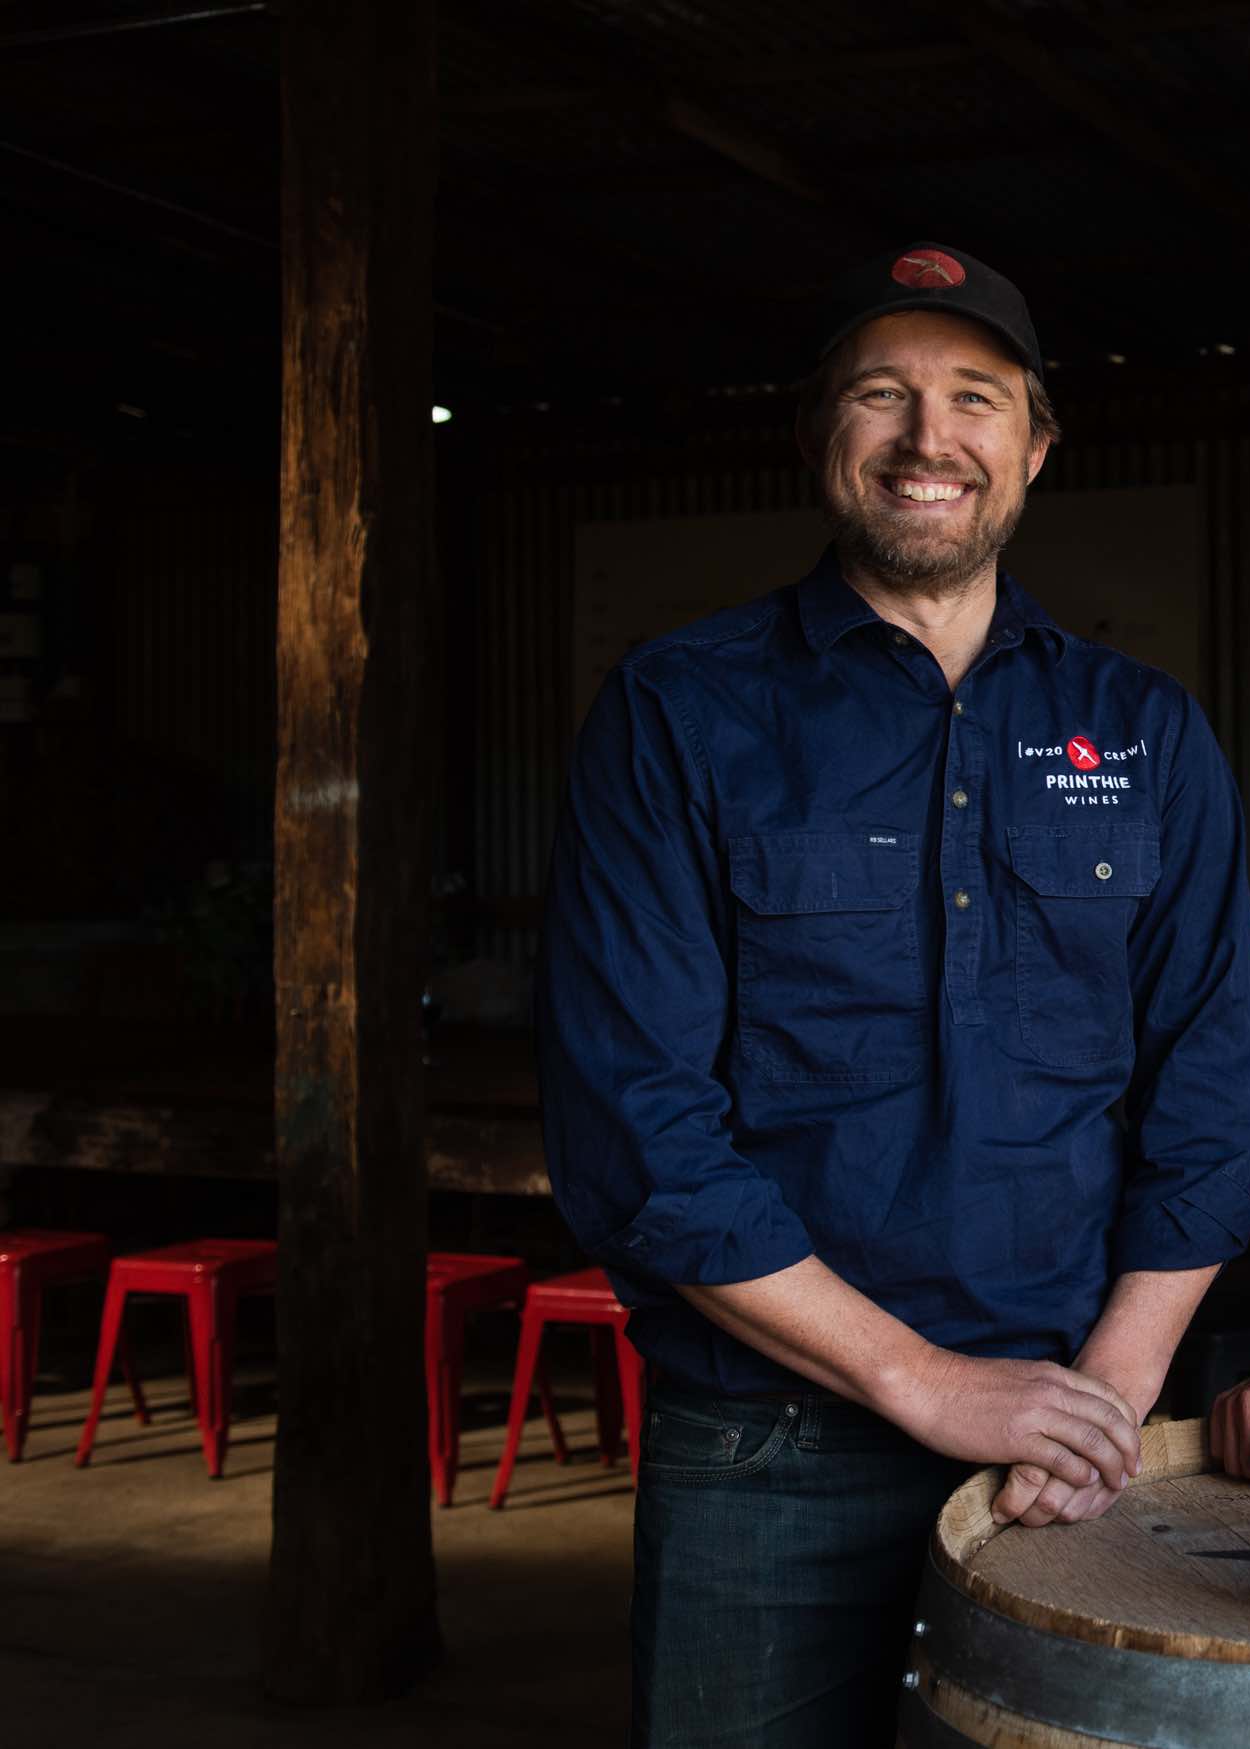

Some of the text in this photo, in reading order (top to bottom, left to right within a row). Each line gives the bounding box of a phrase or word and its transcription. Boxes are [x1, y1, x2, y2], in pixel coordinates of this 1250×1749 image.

[1104, 745, 1138, 761] CREW
[1046, 774, 1131, 789] PRINTHIE
[1065, 795, 1119, 805] WINES
